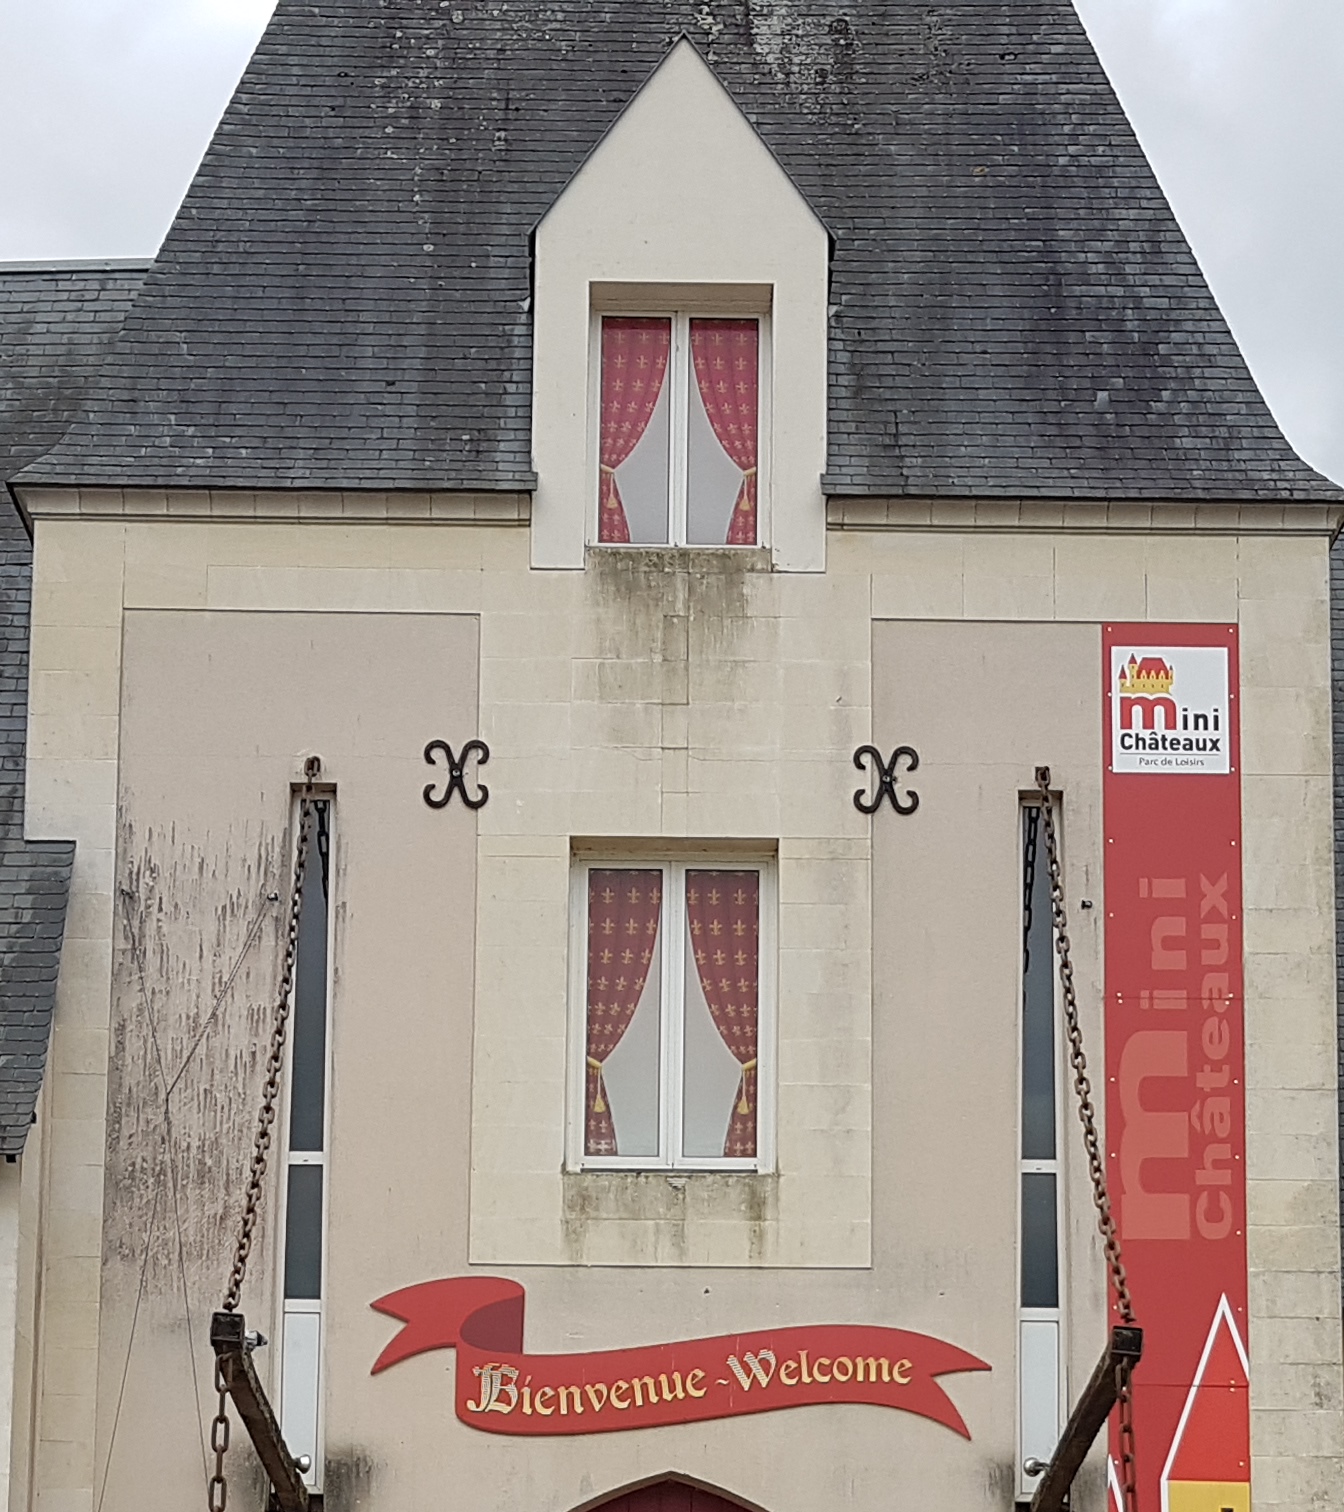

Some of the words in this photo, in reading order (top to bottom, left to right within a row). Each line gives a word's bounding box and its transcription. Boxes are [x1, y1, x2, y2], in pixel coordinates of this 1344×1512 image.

[1119, 696, 1219, 731] mini
[1120, 731, 1221, 752] Châteaux
[1138, 757, 1158, 766] Parc
[1160, 757, 1173, 766] de
[1175, 757, 1205, 766] Loisirs
[1190, 871, 1233, 1241] Châteaux
[466, 1362, 707, 1416] Bienvenue
